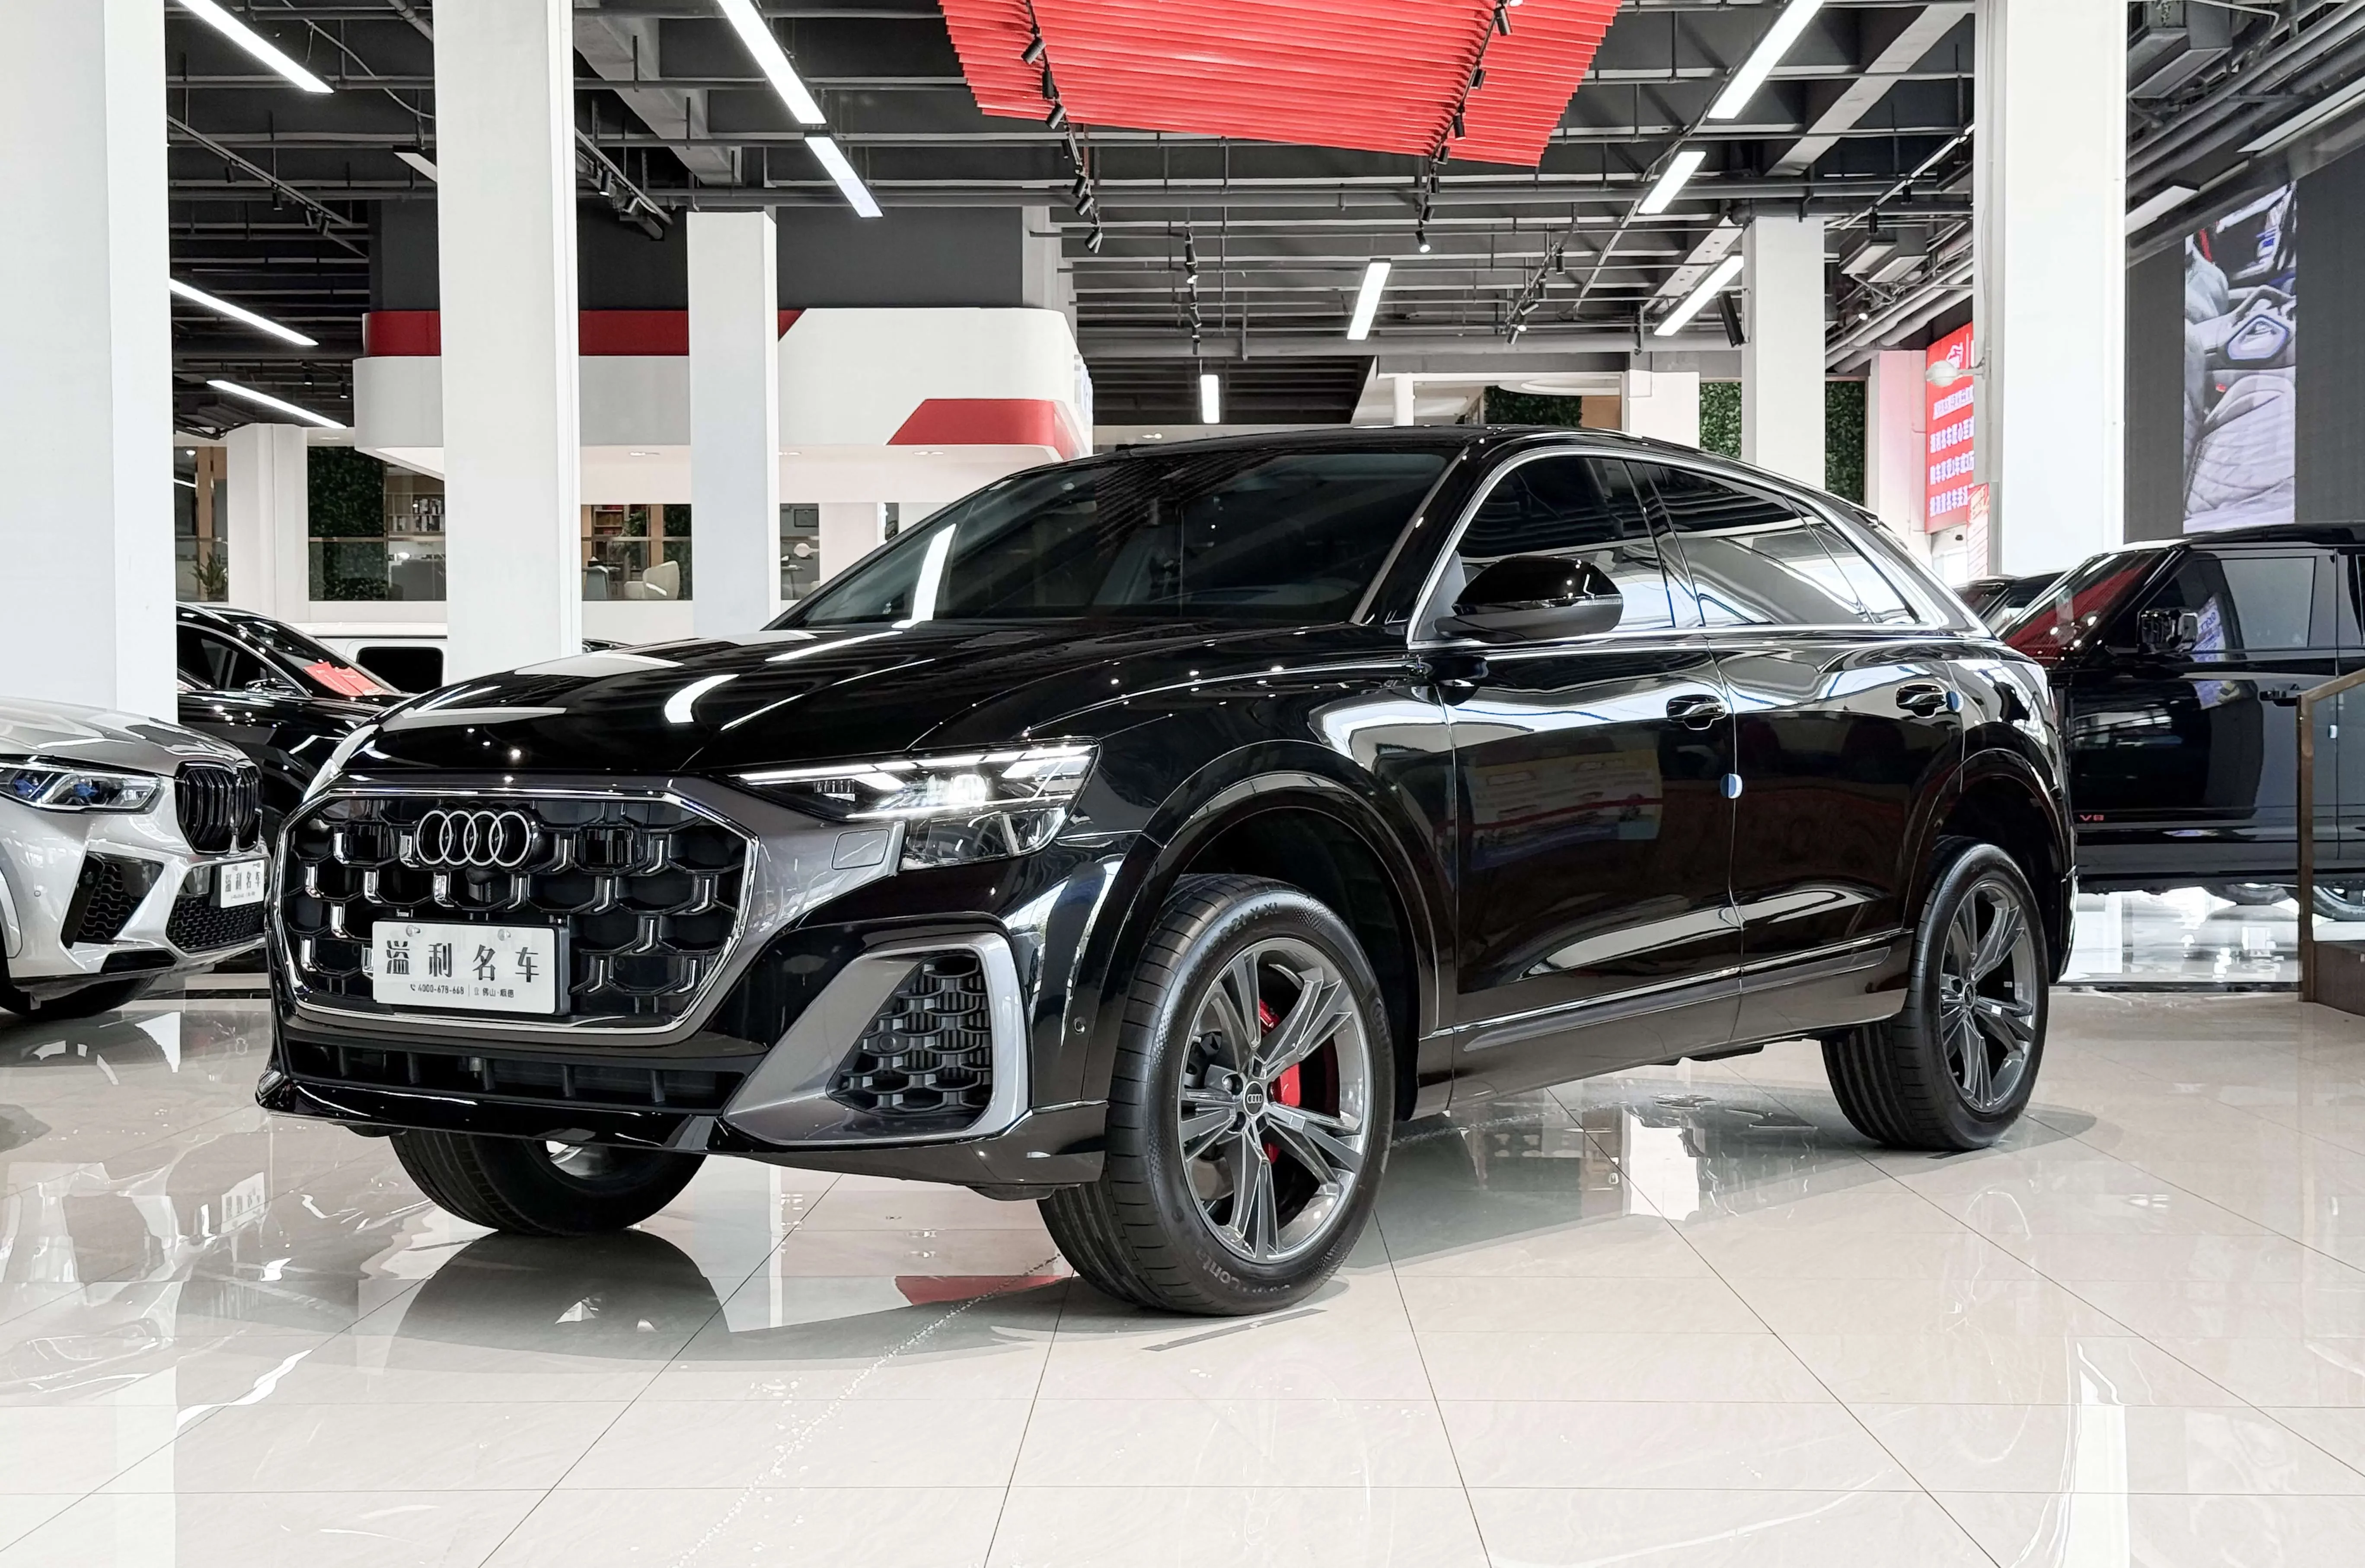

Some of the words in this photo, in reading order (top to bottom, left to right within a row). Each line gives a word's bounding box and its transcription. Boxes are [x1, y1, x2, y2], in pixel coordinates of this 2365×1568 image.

[386, 940, 539, 983] 溢利名车
[418, 984, 464, 994] 4000-678-668
